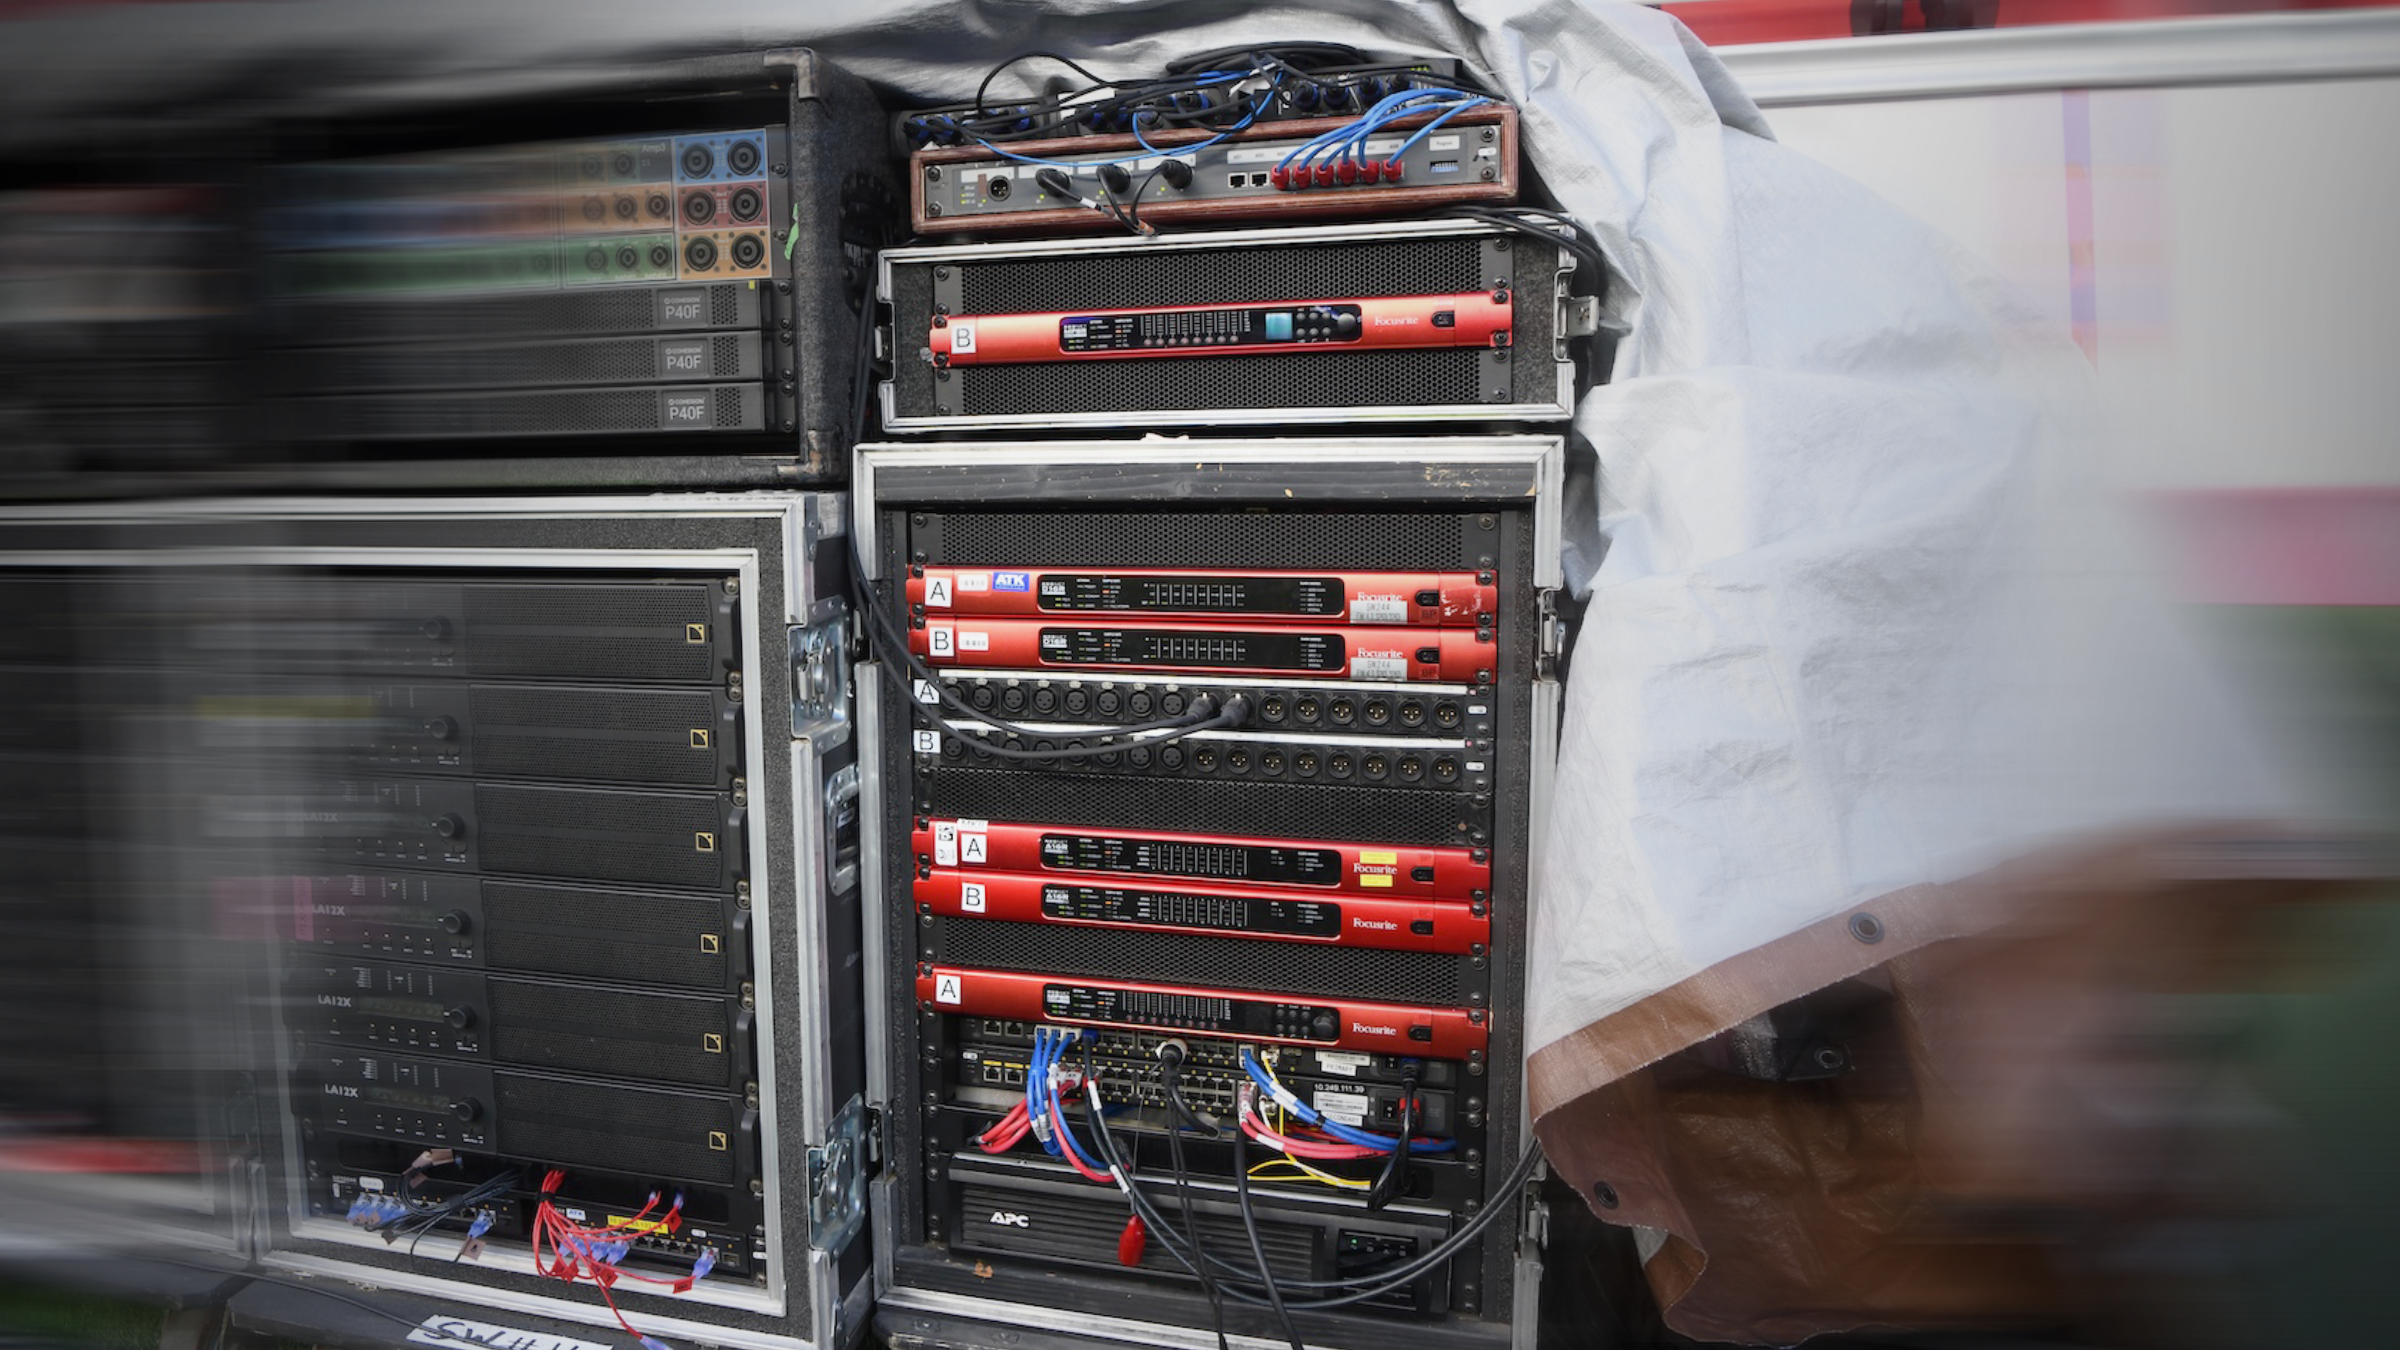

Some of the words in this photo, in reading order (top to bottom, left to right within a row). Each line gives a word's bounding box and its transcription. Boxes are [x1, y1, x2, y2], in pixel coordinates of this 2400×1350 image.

[665, 304, 700, 320] P40F
[1374, 315, 1419, 327] Focusrite
[956, 328, 971, 348] B
[666, 354, 702, 370] P40F
[669, 405, 704, 421] P40F
[996, 574, 1025, 586] ATK
[930, 581, 945, 601] A
[1357, 592, 1402, 601] Focusrite
[934, 631, 949, 650] B
[1357, 647, 1403, 658] Focusrite
[919, 681, 934, 700] A
[920, 732, 933, 750] B
[966, 837, 982, 858] A
[1353, 863, 1397, 875] Focusrite
[966, 887, 981, 906] B
[312, 904, 346, 917] LA12X
[1353, 917, 1397, 931] Focusrite
[941, 979, 956, 998] A
[317, 994, 352, 1008] LA12X
[1353, 1022, 1396, 1037] Focusrite
[324, 1083, 359, 1098] LA12X
[990, 1211, 1029, 1227] APC
